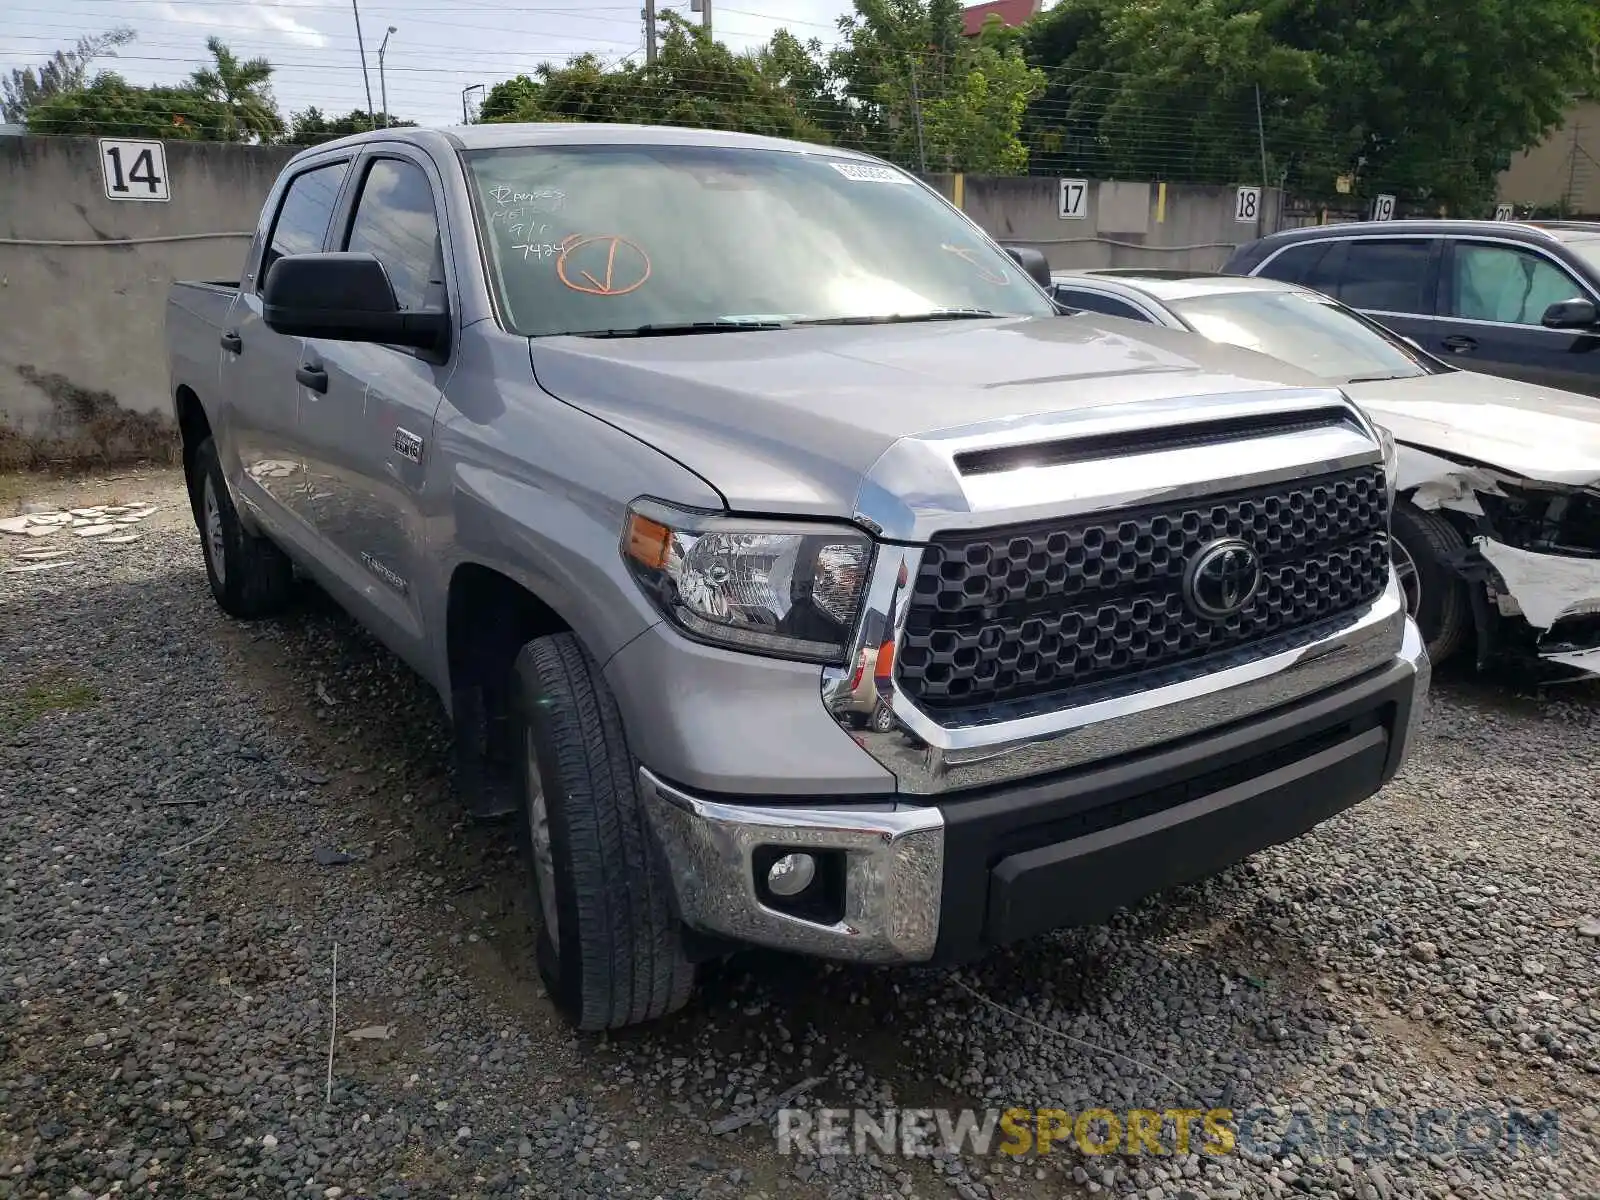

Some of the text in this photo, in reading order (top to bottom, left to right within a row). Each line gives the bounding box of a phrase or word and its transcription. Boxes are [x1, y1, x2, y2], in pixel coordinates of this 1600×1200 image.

[106, 146, 162, 193] 14
[1063, 184, 1084, 214] 17
[1239, 191, 1256, 217] 18
[1375, 198, 1392, 221] 19
